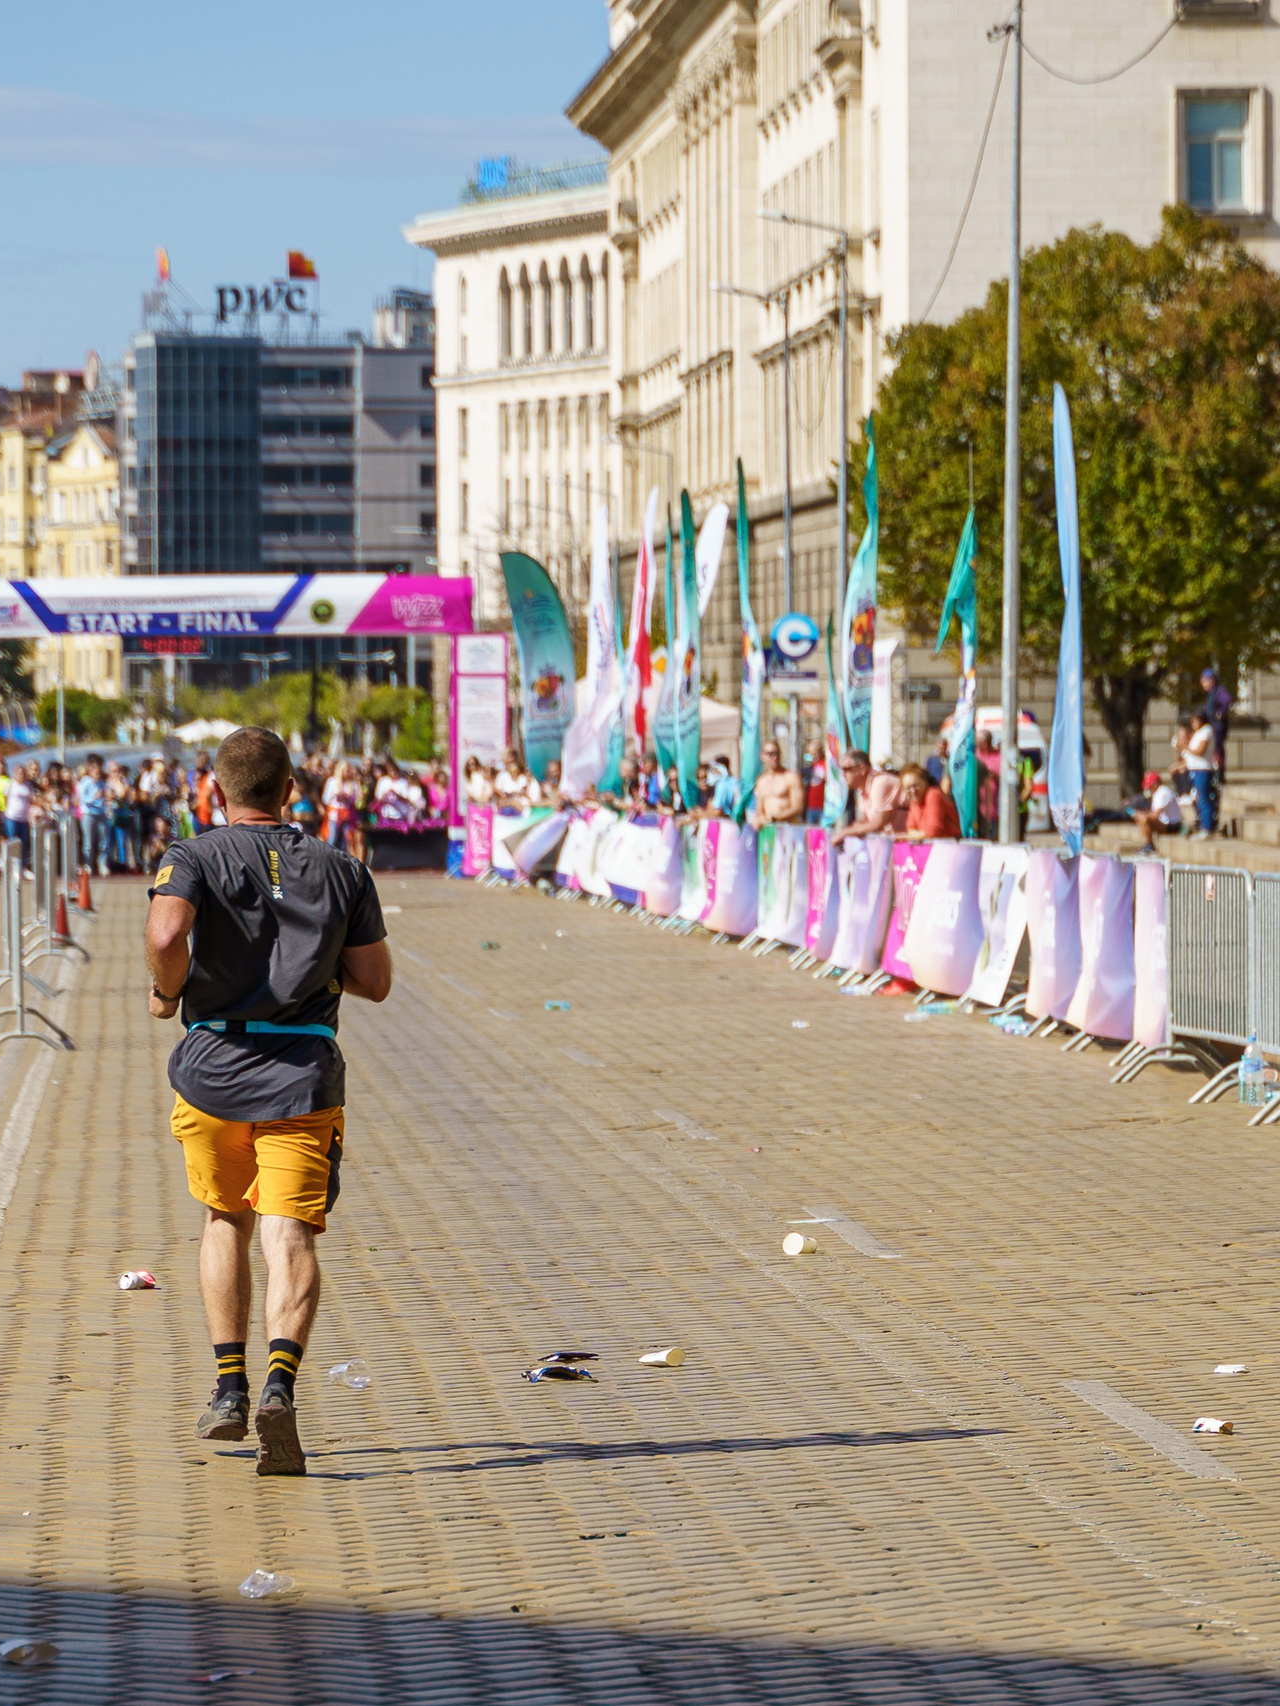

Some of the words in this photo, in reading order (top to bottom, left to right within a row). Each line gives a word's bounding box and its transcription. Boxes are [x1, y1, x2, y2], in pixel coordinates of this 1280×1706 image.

[216, 282, 307, 322] pwc
[66, 614, 153, 633] START
[177, 612, 260, 632] FINAL
